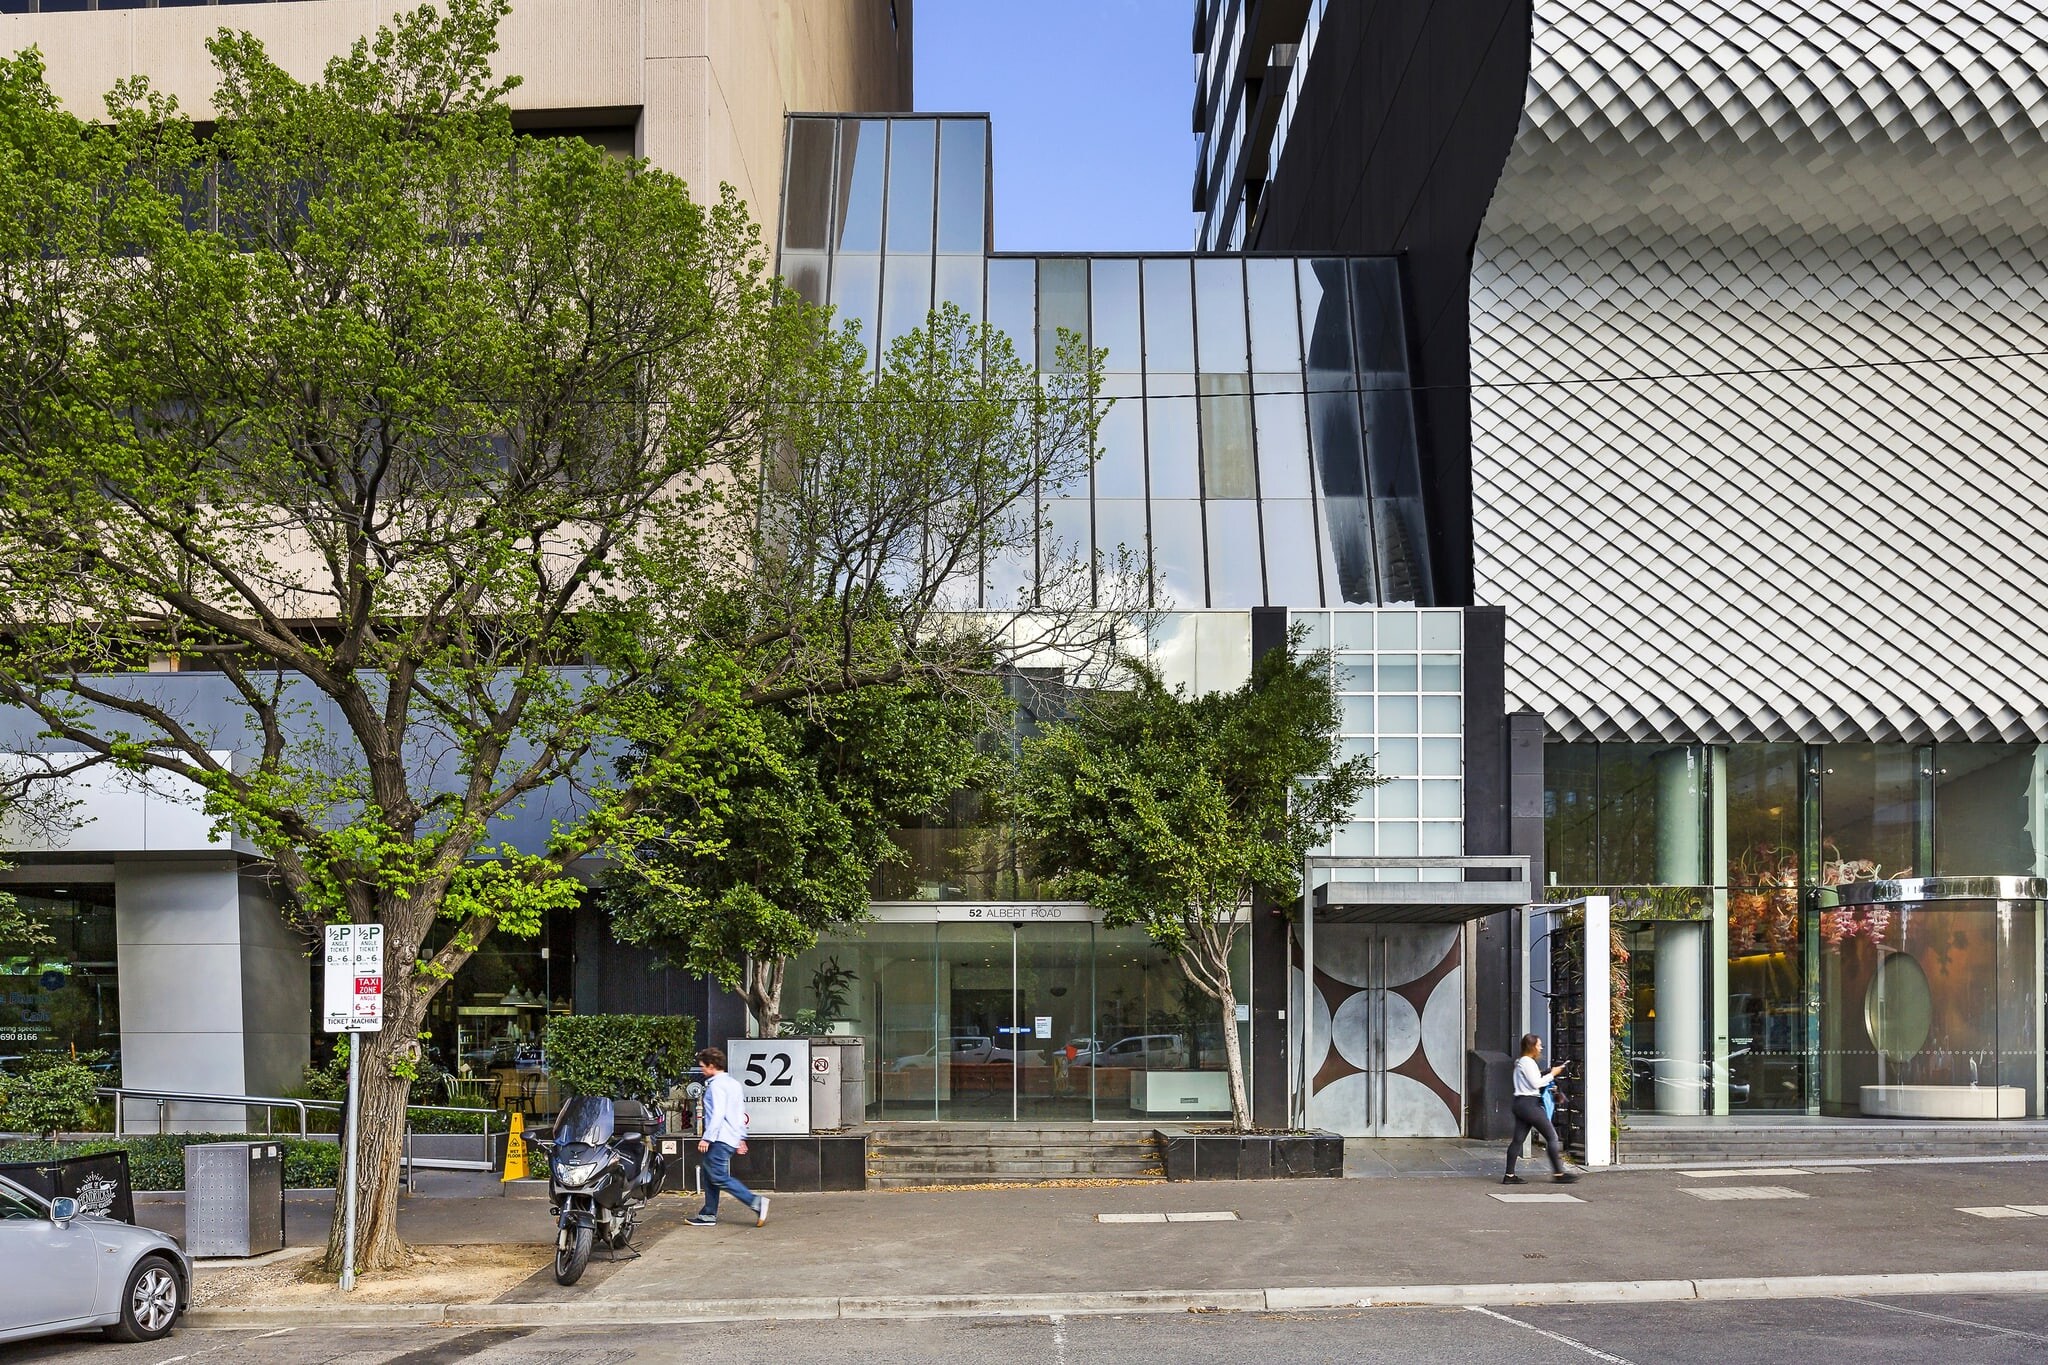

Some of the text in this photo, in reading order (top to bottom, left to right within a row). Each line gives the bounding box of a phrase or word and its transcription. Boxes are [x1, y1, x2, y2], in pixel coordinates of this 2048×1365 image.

[969, 908, 1062, 918] 52 ALBERT ROAD
[358, 978, 379, 986] TAXI
[17, 1033, 38, 1041] 8166
[744, 1053, 793, 1086] 52
